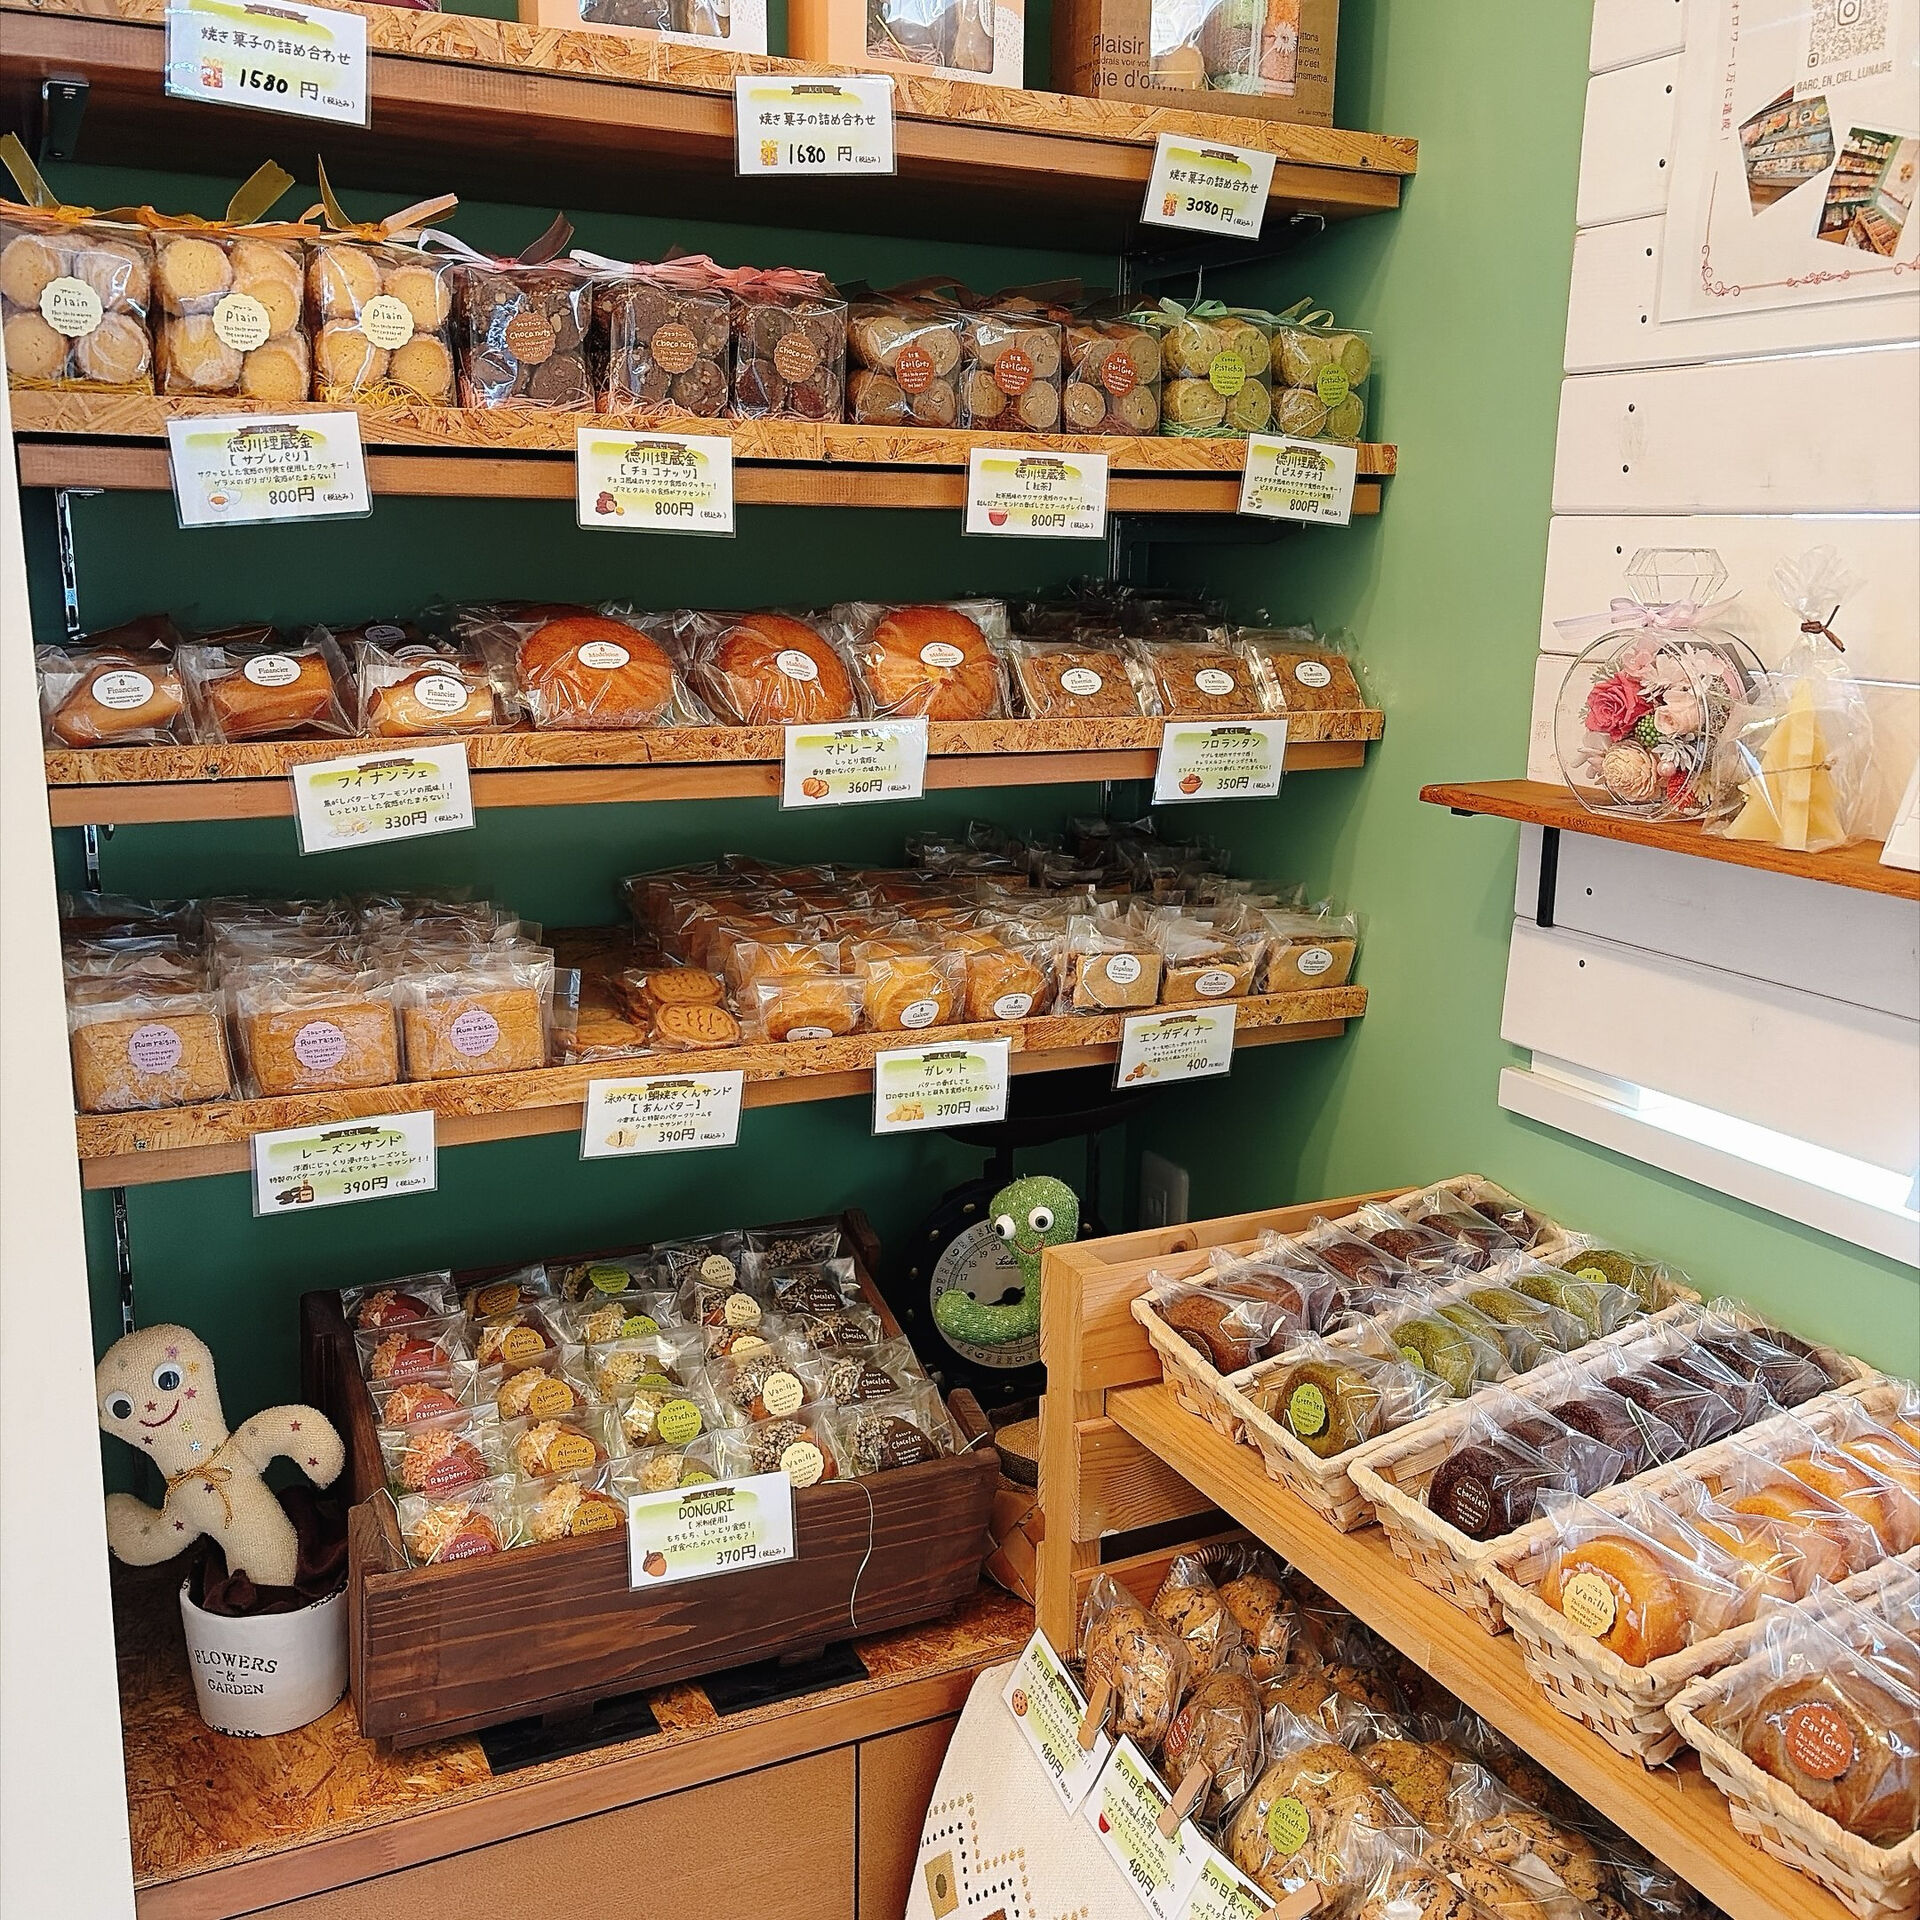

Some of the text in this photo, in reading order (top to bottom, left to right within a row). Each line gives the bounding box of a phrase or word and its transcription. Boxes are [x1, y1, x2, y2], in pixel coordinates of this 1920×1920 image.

[200, 26, 352, 66] 焼き菓子の詰め合わせ
[1092, 34, 1145, 55] Plaisir
[238, 68, 289, 94] 1580
[299, 80, 319, 101] 円
[1091, 67, 1118, 93] joie
[758, 112, 877, 127] 焼き菓子の詰め合わせ
[789, 143, 826, 165] 1680
[837, 145, 853, 162] 円
[1169, 169, 1260, 194] 焼き菓子の詰め合わせ
[53, 294, 89, 308] Plain
[225, 309, 258, 324] Plain
[372, 308, 404, 322] Plain
[227, 433, 315, 454] 徳川埋蔵金
[624, 449, 698, 468] 徳川埋蔵金
[1276, 452, 1329, 472] 徳川埋蔵金
[1015, 467, 1069, 482] 徳川埋蔵金
[268, 486, 315, 506] 800円
[654, 501, 694, 518] 800円
[1289, 498, 1319, 514] 800円
[1031, 513, 1066, 528] 800円
[257, 666, 289, 675] Financier
[107, 685, 141, 695] Financier
[426, 689, 456, 699] Financier
[823, 741, 886, 756] マドレーヌ
[1200, 738, 1261, 750] フロランタン
[337, 768, 429, 790] フィナンシェ
[847, 778, 883, 794] 360円
[1216, 776, 1250, 790] 350円
[384, 810, 428, 831] 330円
[456, 1026, 472, 1036] Rum
[1140, 1025, 1214, 1043] エンガディナー
[134, 1041, 152, 1050] Rum
[300, 1038, 317, 1048] Rum
[924, 1062, 967, 1077] ガレット
[1186, 1057, 1209, 1072] 400
[936, 1100, 971, 1117] 370円
[658, 1127, 696, 1143] 390円
[301, 1134, 404, 1159] レーズンサンド
[343, 1175, 389, 1196] 390円
[951, 1248, 960, 1257] 9
[960, 1273, 968, 1281] 17
[509, 1336, 539, 1349] Almond
[536, 1389, 565, 1404] Almond
[768, 1381, 797, 1398] Vanilla
[661, 1409, 698, 1425] Pistachio
[557, 1445, 588, 1457] Almond
[785, 1451, 817, 1469] Vanilla
[429, 1469, 471, 1486] Raspberry
[1456, 1487, 1489, 1511] Chocolate
[678, 1498, 736, 1521] DONGURI
[579, 1512, 609, 1526] Almond
[716, 1544, 756, 1566] 370円
[1575, 1585, 1609, 1615] Vanilla
[194, 1649, 278, 1674] FLOWERS
[207, 1678, 264, 1695] GARDEN
[1800, 1716, 1847, 1757] Earl Grey
[1041, 1742, 1065, 1779] 480円
[1274, 1807, 1306, 1834] Pistachio
[1129, 1858, 1156, 1897] 480円
